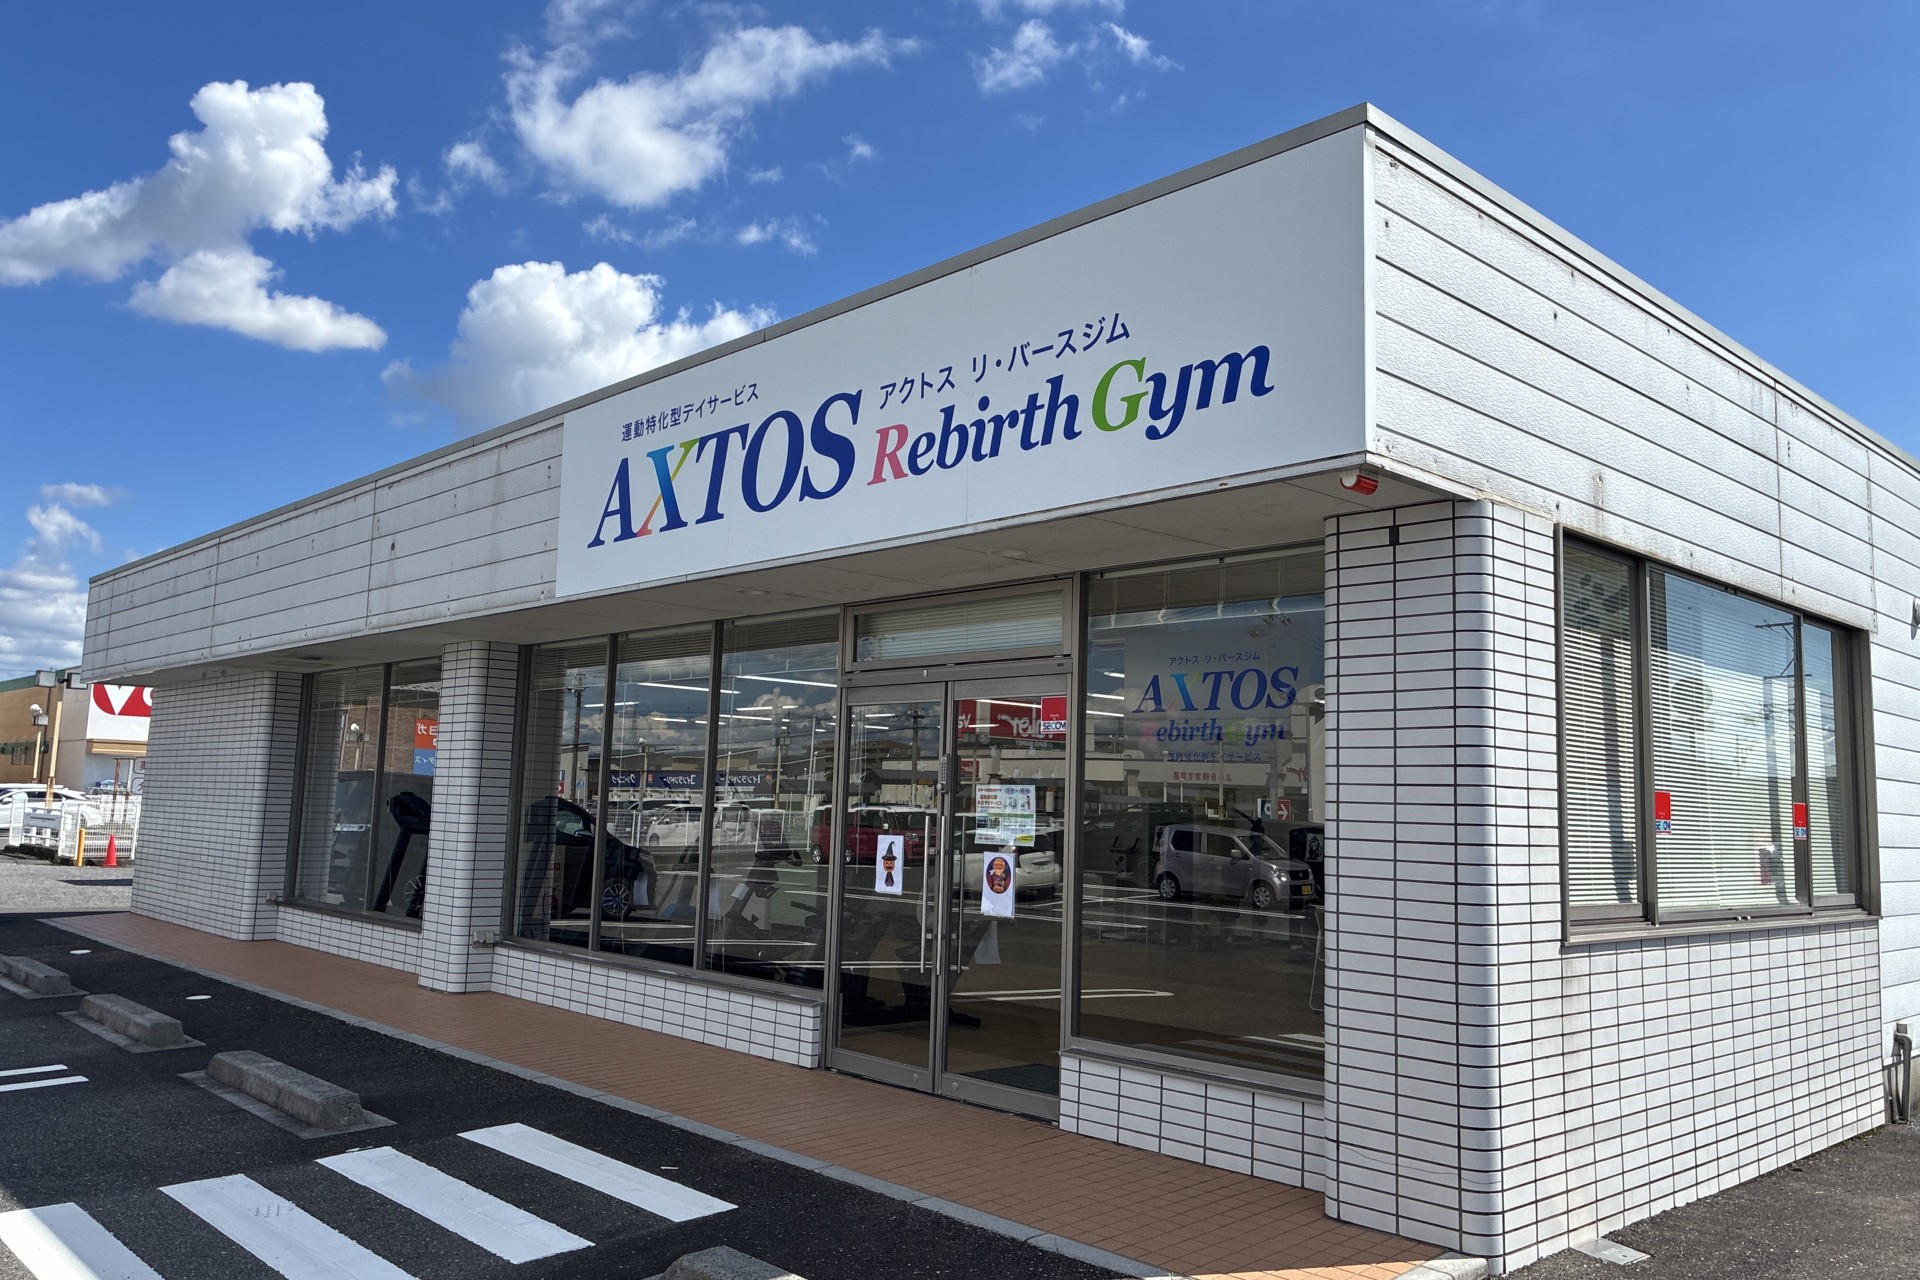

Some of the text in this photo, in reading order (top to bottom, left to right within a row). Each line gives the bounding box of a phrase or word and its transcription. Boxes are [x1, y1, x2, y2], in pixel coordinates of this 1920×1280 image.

[880, 313, 1130, 410] アクトス リ・バースジム
[621, 383, 759, 442] 運動特化型デイサービス
[587, 344, 1275, 549] AXTOS Rebirth Gym
[1169, 655, 1199, 666] アクトス
[1132, 666, 1299, 713] AXTOS
[1042, 722, 1067, 731] SECOM
